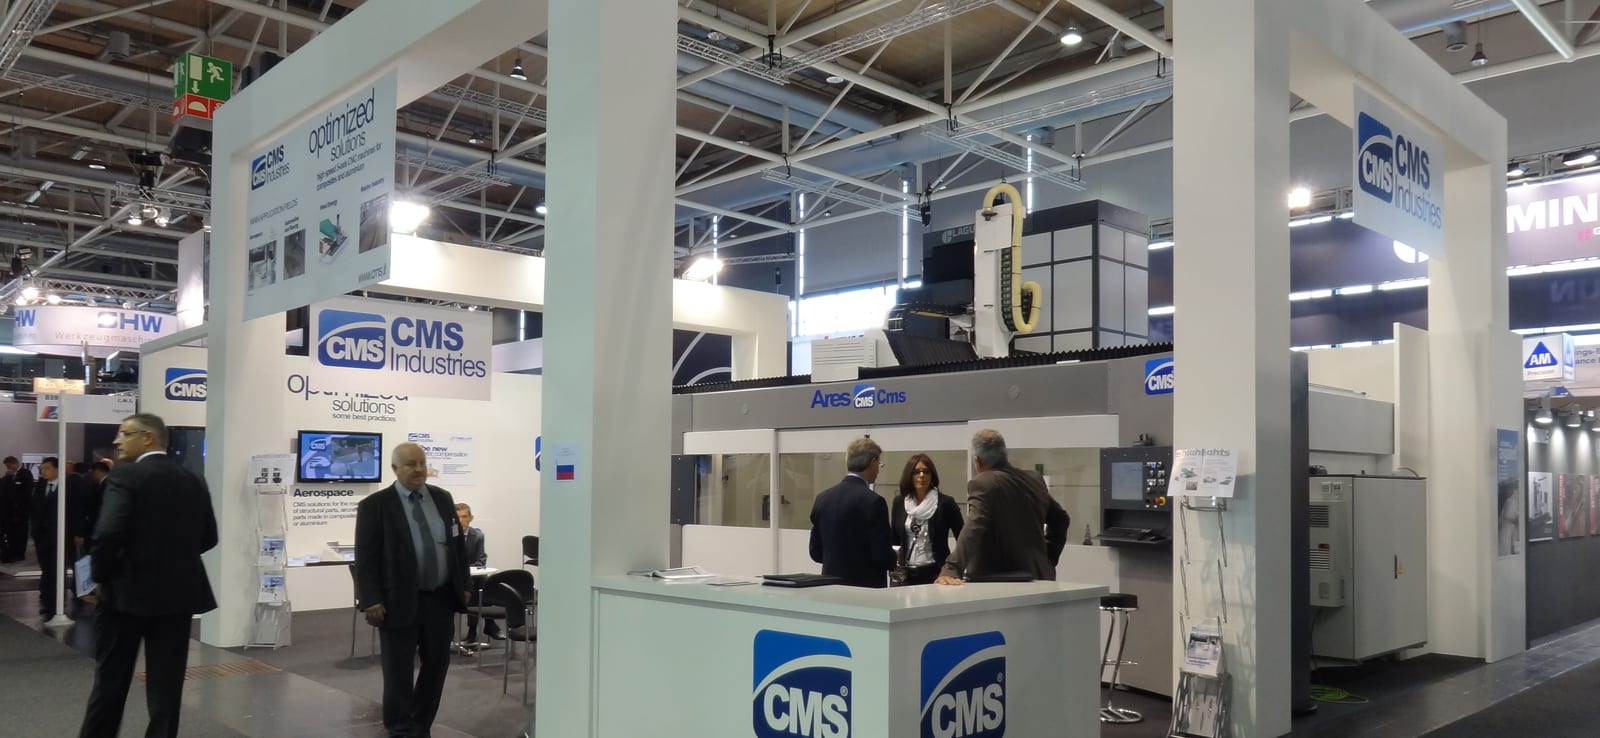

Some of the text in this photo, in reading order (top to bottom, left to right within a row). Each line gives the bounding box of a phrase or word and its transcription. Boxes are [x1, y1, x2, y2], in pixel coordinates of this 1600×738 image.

[309, 87, 375, 159] optimized
[267, 144, 284, 168] CMS
[330, 131, 366, 161] solutions
[1362, 150, 1392, 193] CMS
[1394, 134, 1430, 190] CMS
[1394, 174, 1442, 230] Industries
[55, 328, 147, 344] Werkzeugmasch
[391, 316, 464, 351] CMS
[326, 336, 384, 363] CMS
[1529, 352, 1552, 366] AM
[390, 347, 486, 378] Industries
[169, 382, 207, 398] CMS
[1148, 373, 1174, 391] CMS
[332, 398, 396, 415] solutions
[811, 388, 906, 408] Ares CMS Cms
[293, 488, 355, 499] Aerospace
